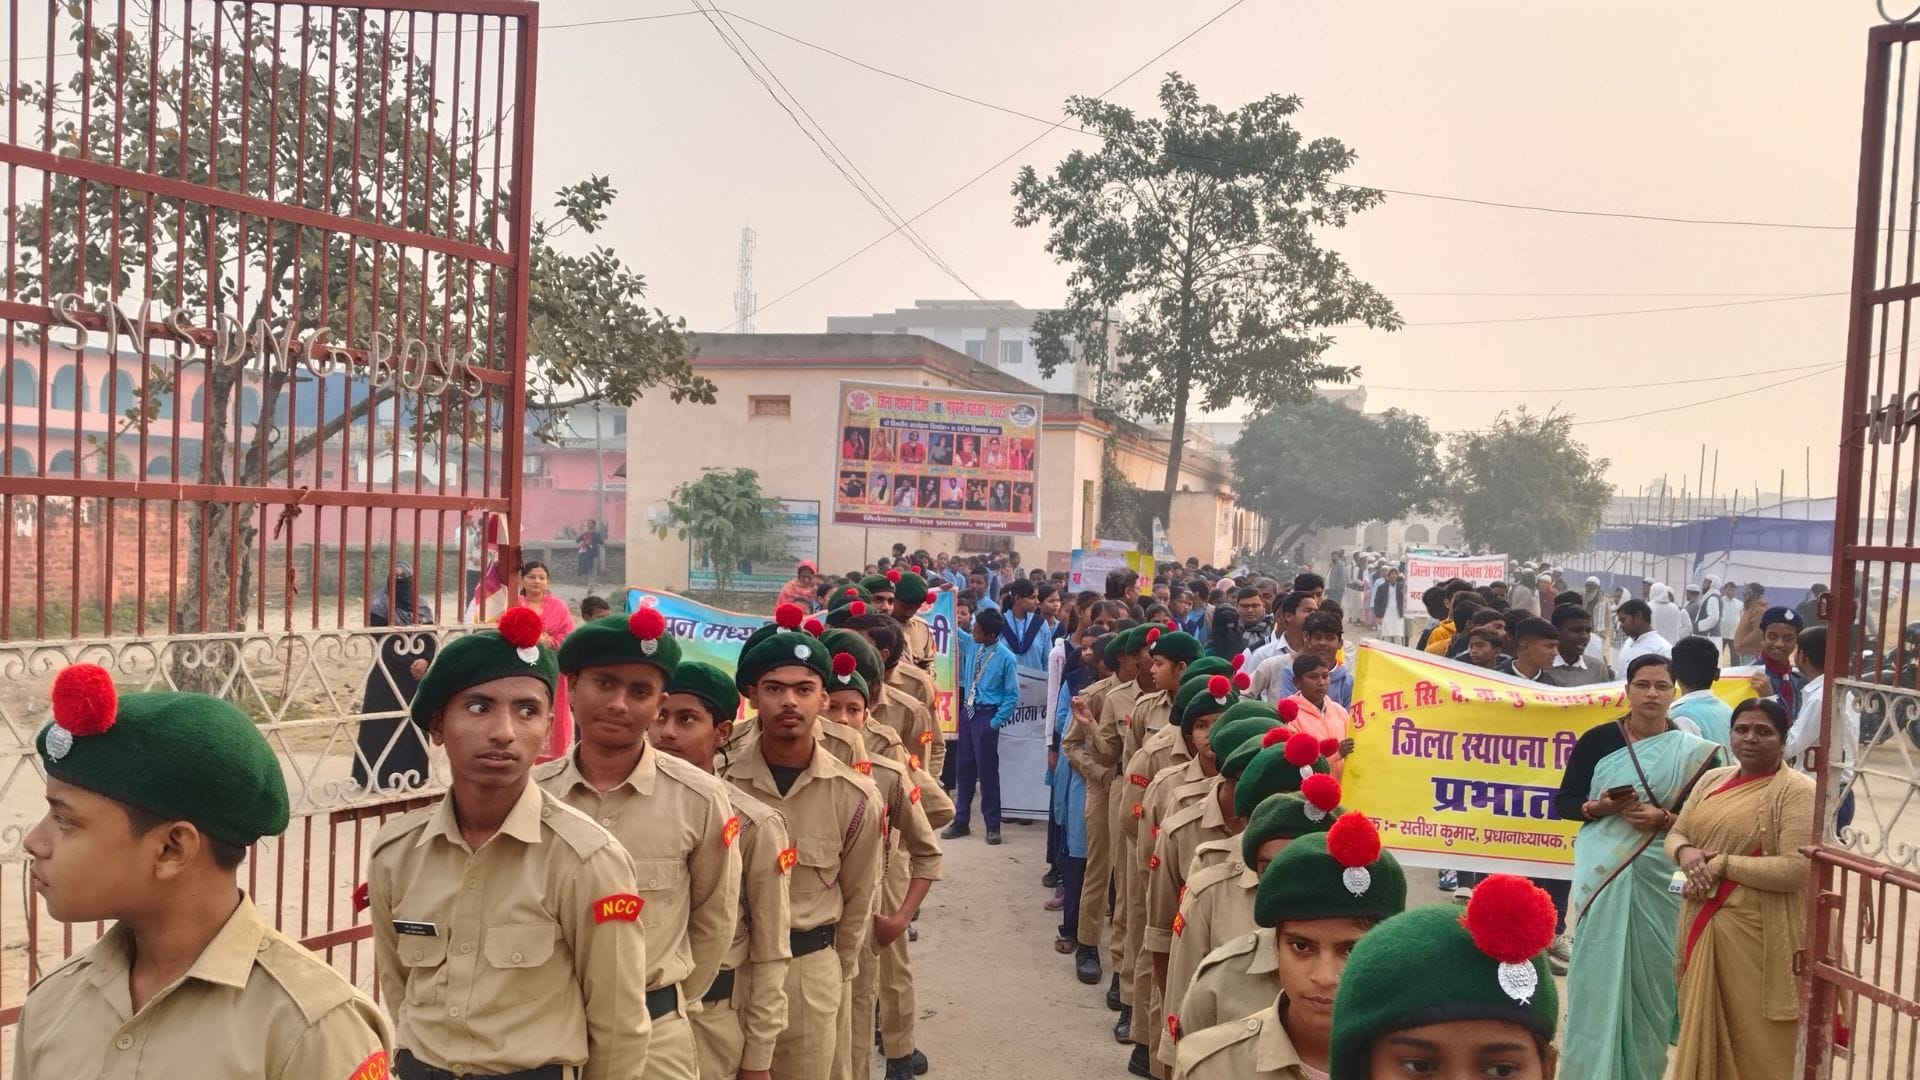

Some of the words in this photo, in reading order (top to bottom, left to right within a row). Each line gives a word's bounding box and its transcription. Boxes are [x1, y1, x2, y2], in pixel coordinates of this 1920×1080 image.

[1410, 562, 1431, 577] जिला
[1433, 565, 1460, 578] स्थापना
[1462, 562, 1482, 578] दिवस
[1484, 565, 1503, 578] 2025
[1392, 717, 1458, 760] जिला
[1462, 733, 1549, 769] स्थापना
[1431, 777, 1562, 821] प्रभात
[1400, 816, 1438, 837] सतीश
[1440, 824, 1480, 847] कुमार,
[1483, 828, 1567, 850] प्रधानाध्यापक,
[603, 899, 637, 917] NCC
